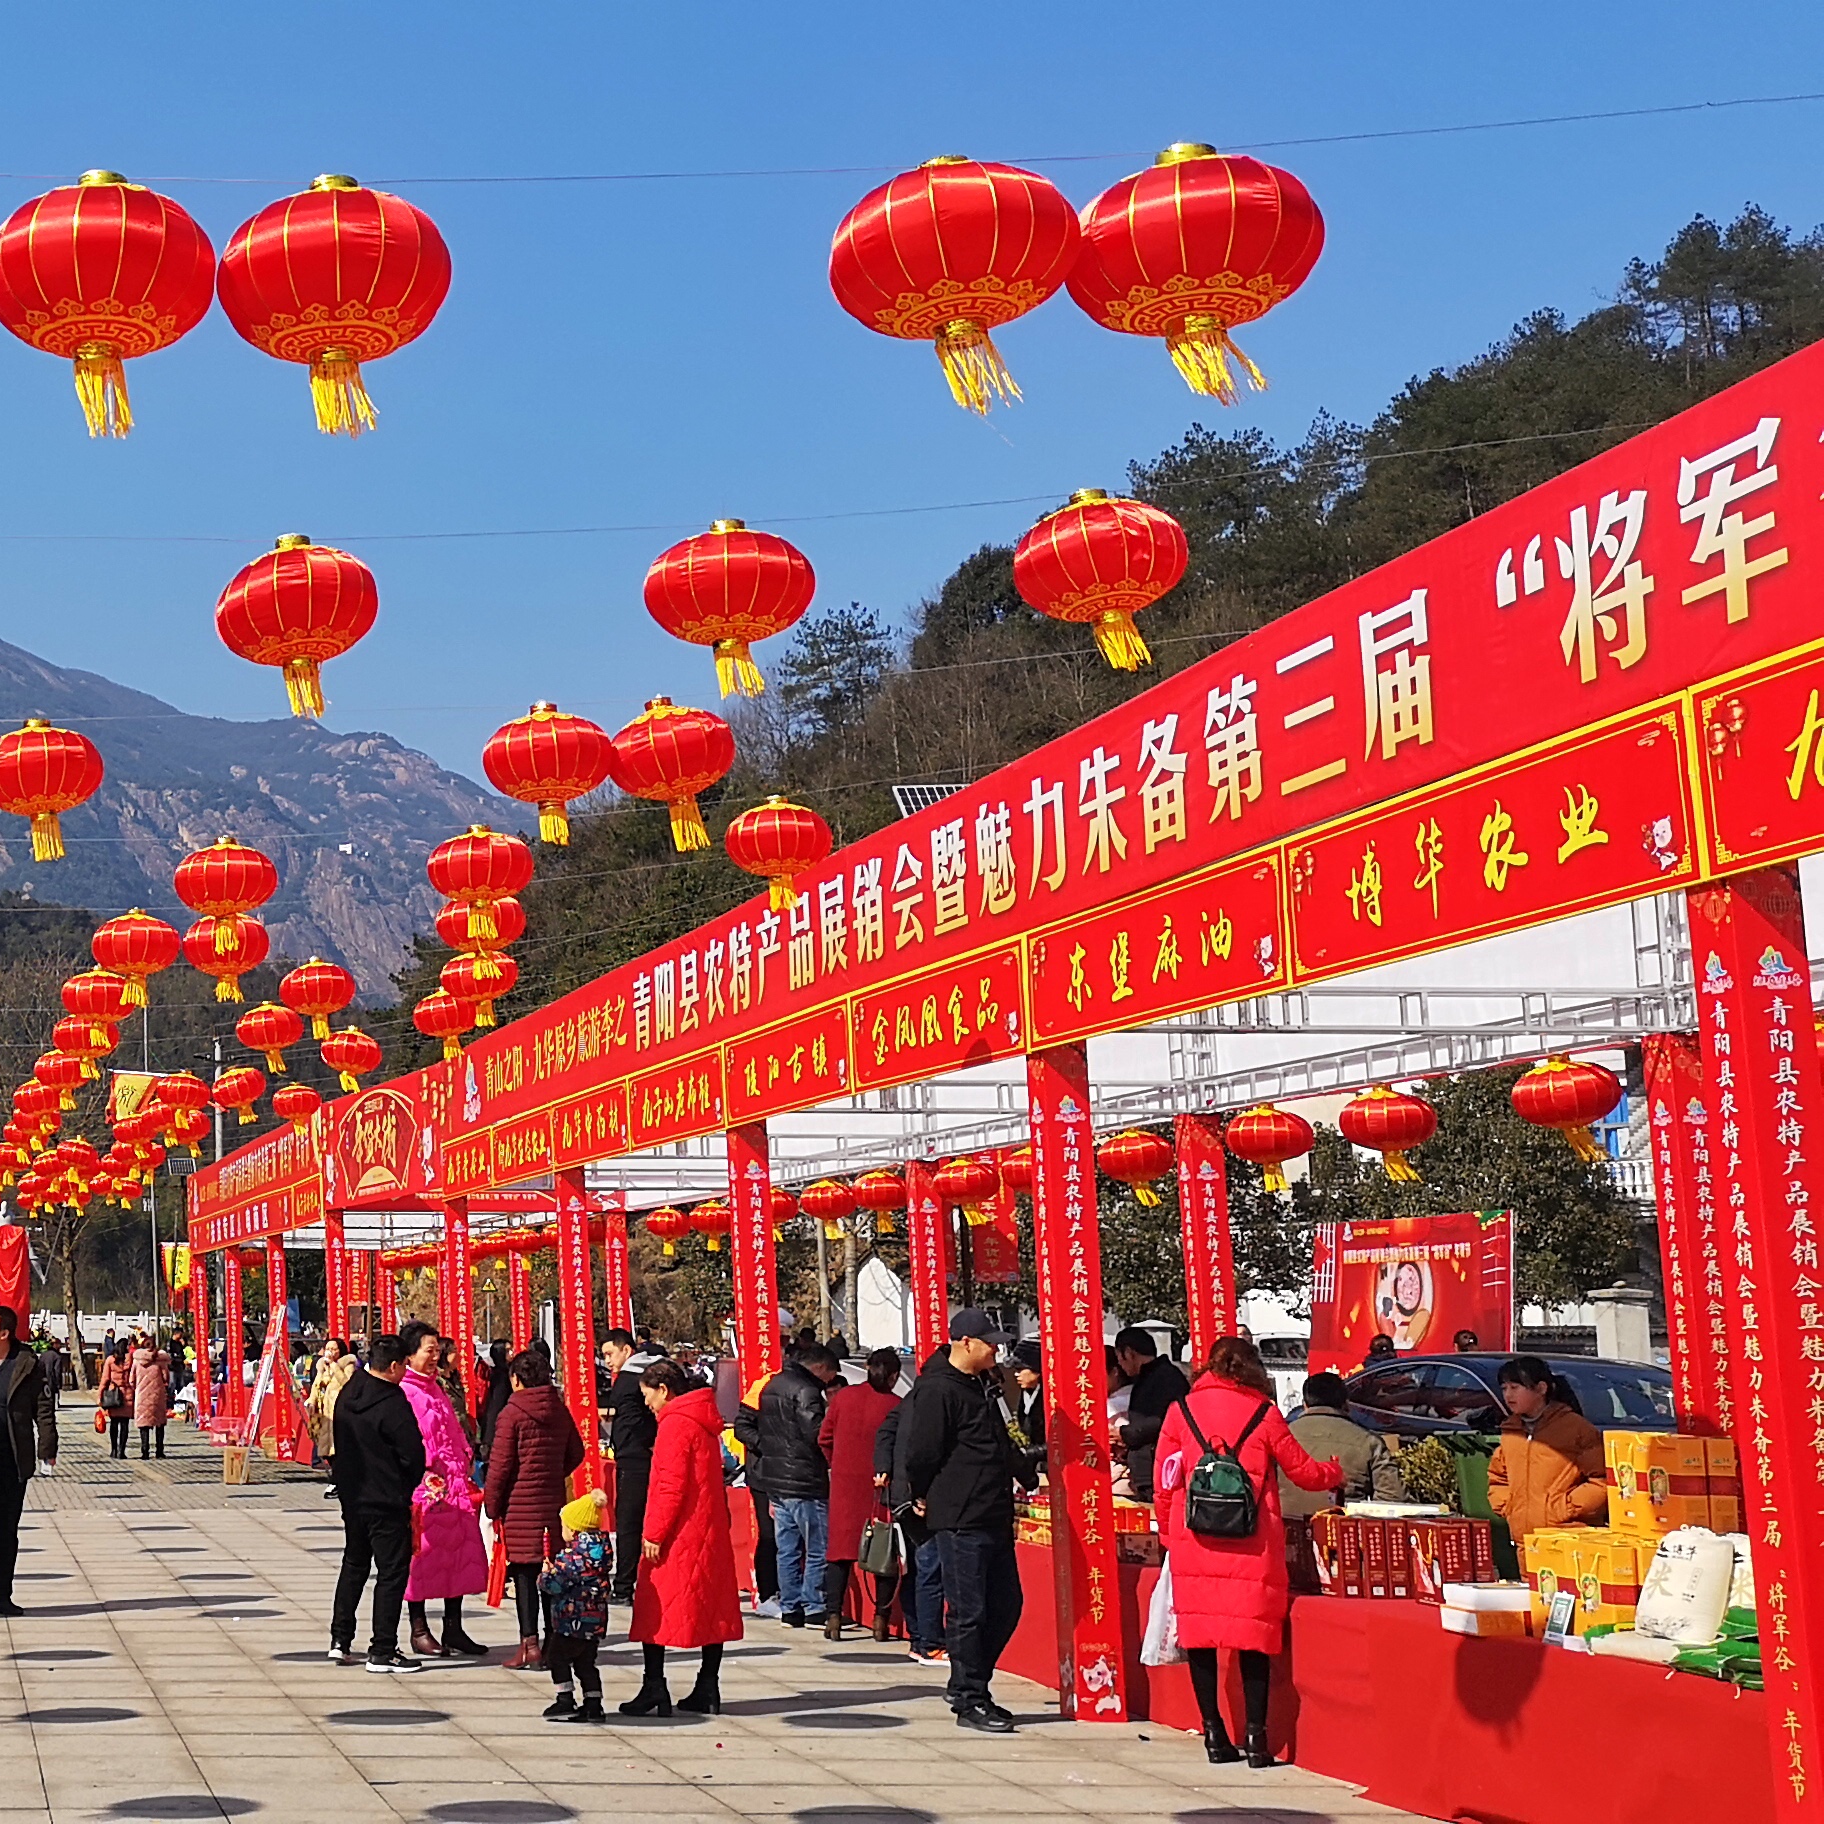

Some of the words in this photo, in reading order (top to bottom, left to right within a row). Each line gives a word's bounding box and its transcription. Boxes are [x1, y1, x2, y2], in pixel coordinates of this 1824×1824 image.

[632, 588, 1434, 1054] 青阳县农特产品展销会暨魅力朱备第三届
[1496, 418, 1824, 683] “将军
[1346, 785, 1609, 927] 博华农业
[1066, 908, 1232, 1011] 东堡麻油
[744, 1037, 828, 1098] 陵阳古镇
[872, 979, 998, 1066] 金凤凰食品
[640, 1082, 711, 1129] 九子山老布鞋
